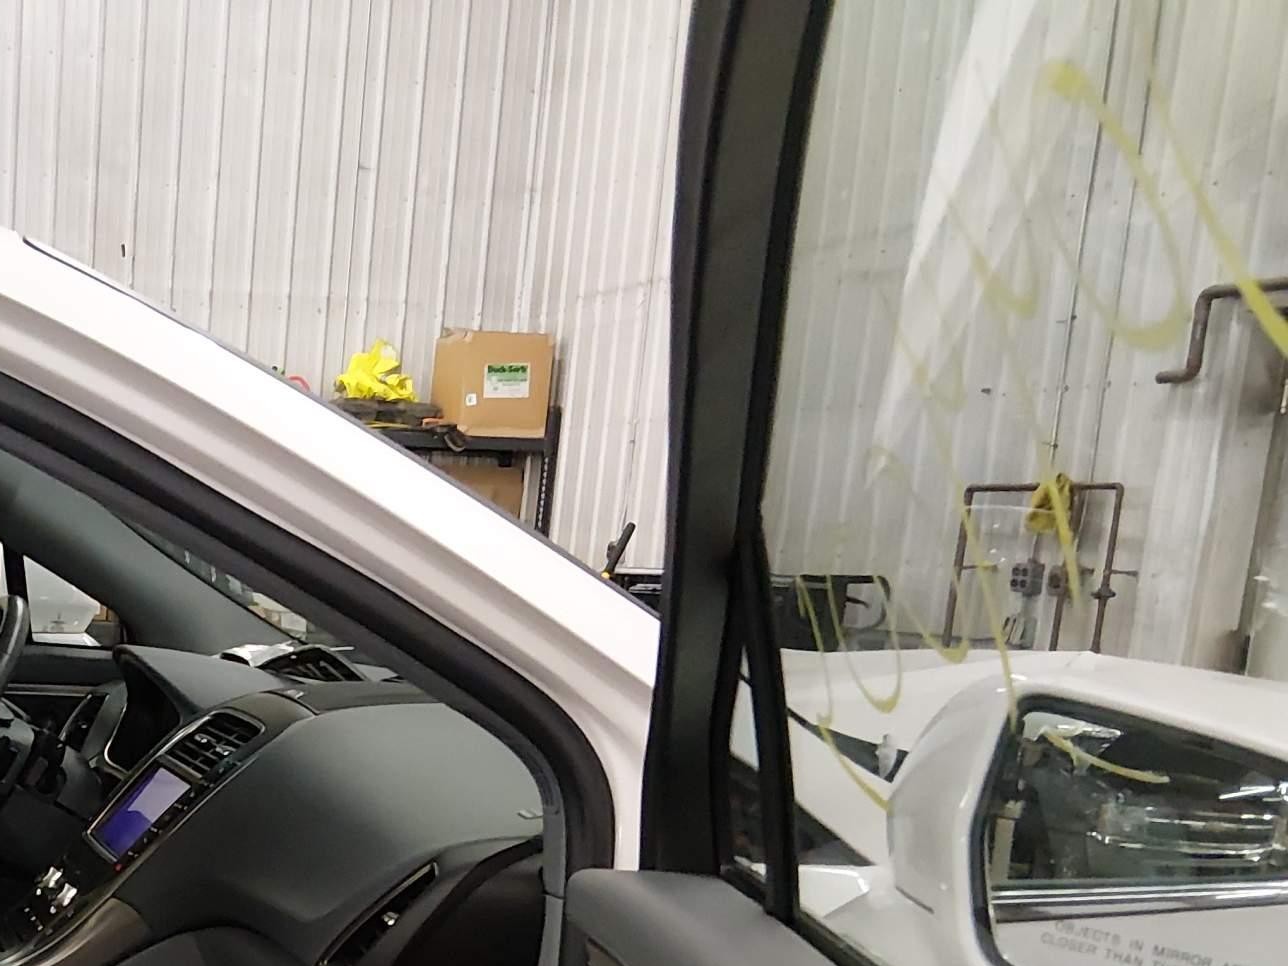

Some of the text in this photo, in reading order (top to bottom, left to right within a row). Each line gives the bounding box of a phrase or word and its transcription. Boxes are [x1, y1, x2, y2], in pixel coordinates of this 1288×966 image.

[1040, 931, 1098, 956] CLOSER
[1054, 919, 1121, 945] OBJECTS
[1128, 938, 1145, 952] IN
